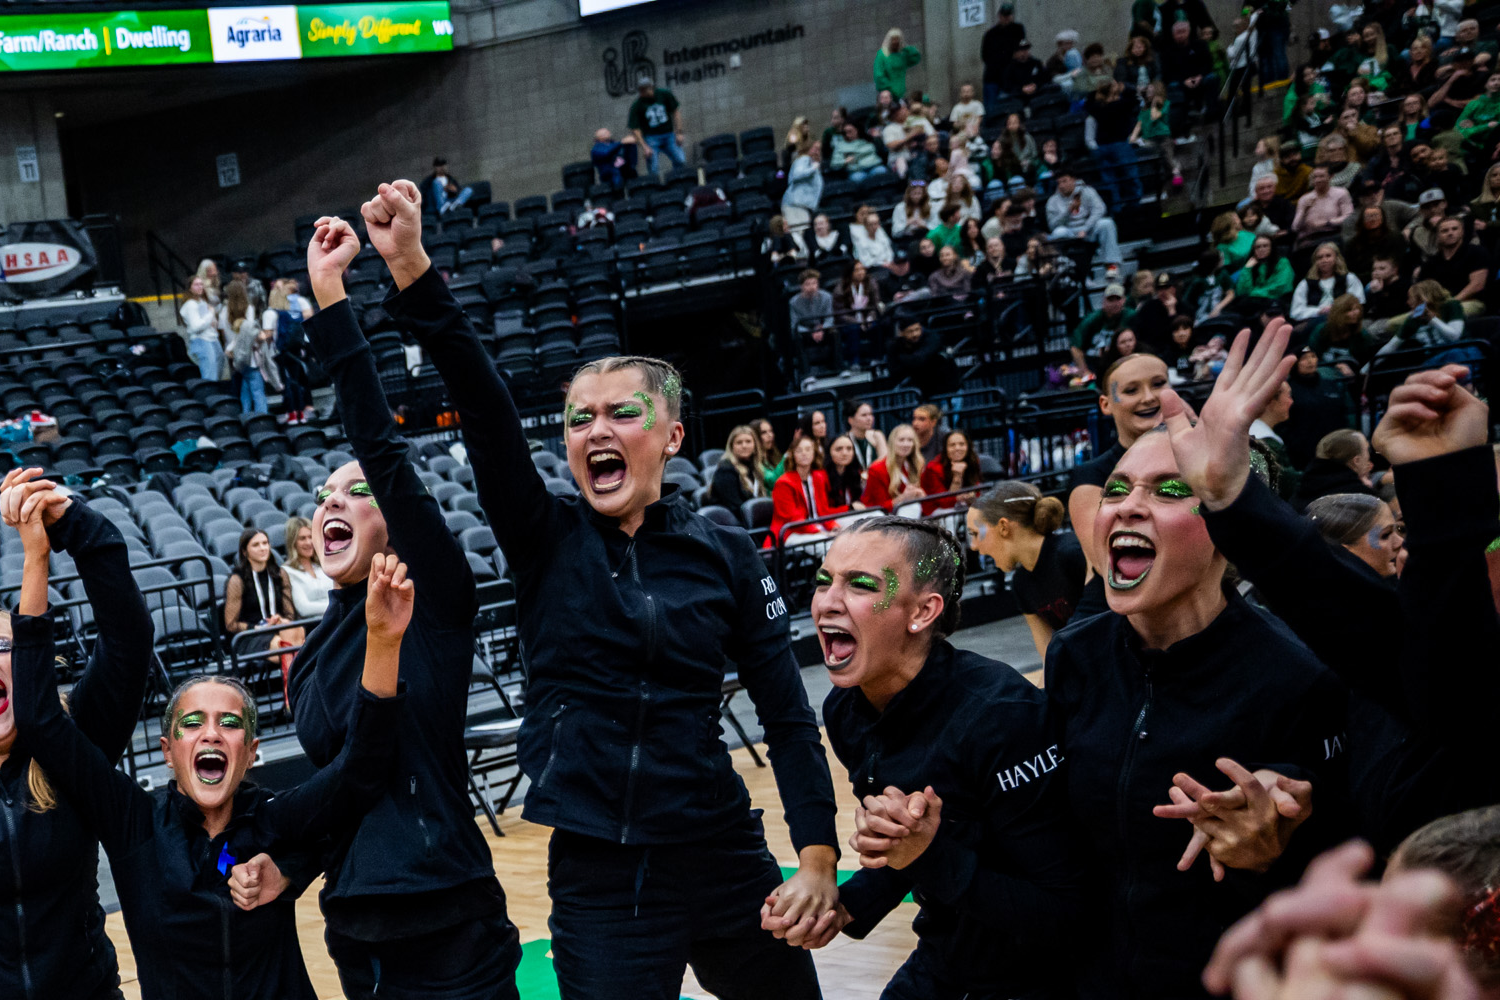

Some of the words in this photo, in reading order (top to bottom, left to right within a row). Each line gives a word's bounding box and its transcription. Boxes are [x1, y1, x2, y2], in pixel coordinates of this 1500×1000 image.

[964, 6, 980, 22] 12
[115, 25, 191, 51] Dwelling
[227, 24, 282, 48] Agraria
[308, 17, 357, 46] Simply
[358, 16, 422, 44] Different
[663, 22, 805, 65] Intermountain
[665, 60, 726, 87] Health
